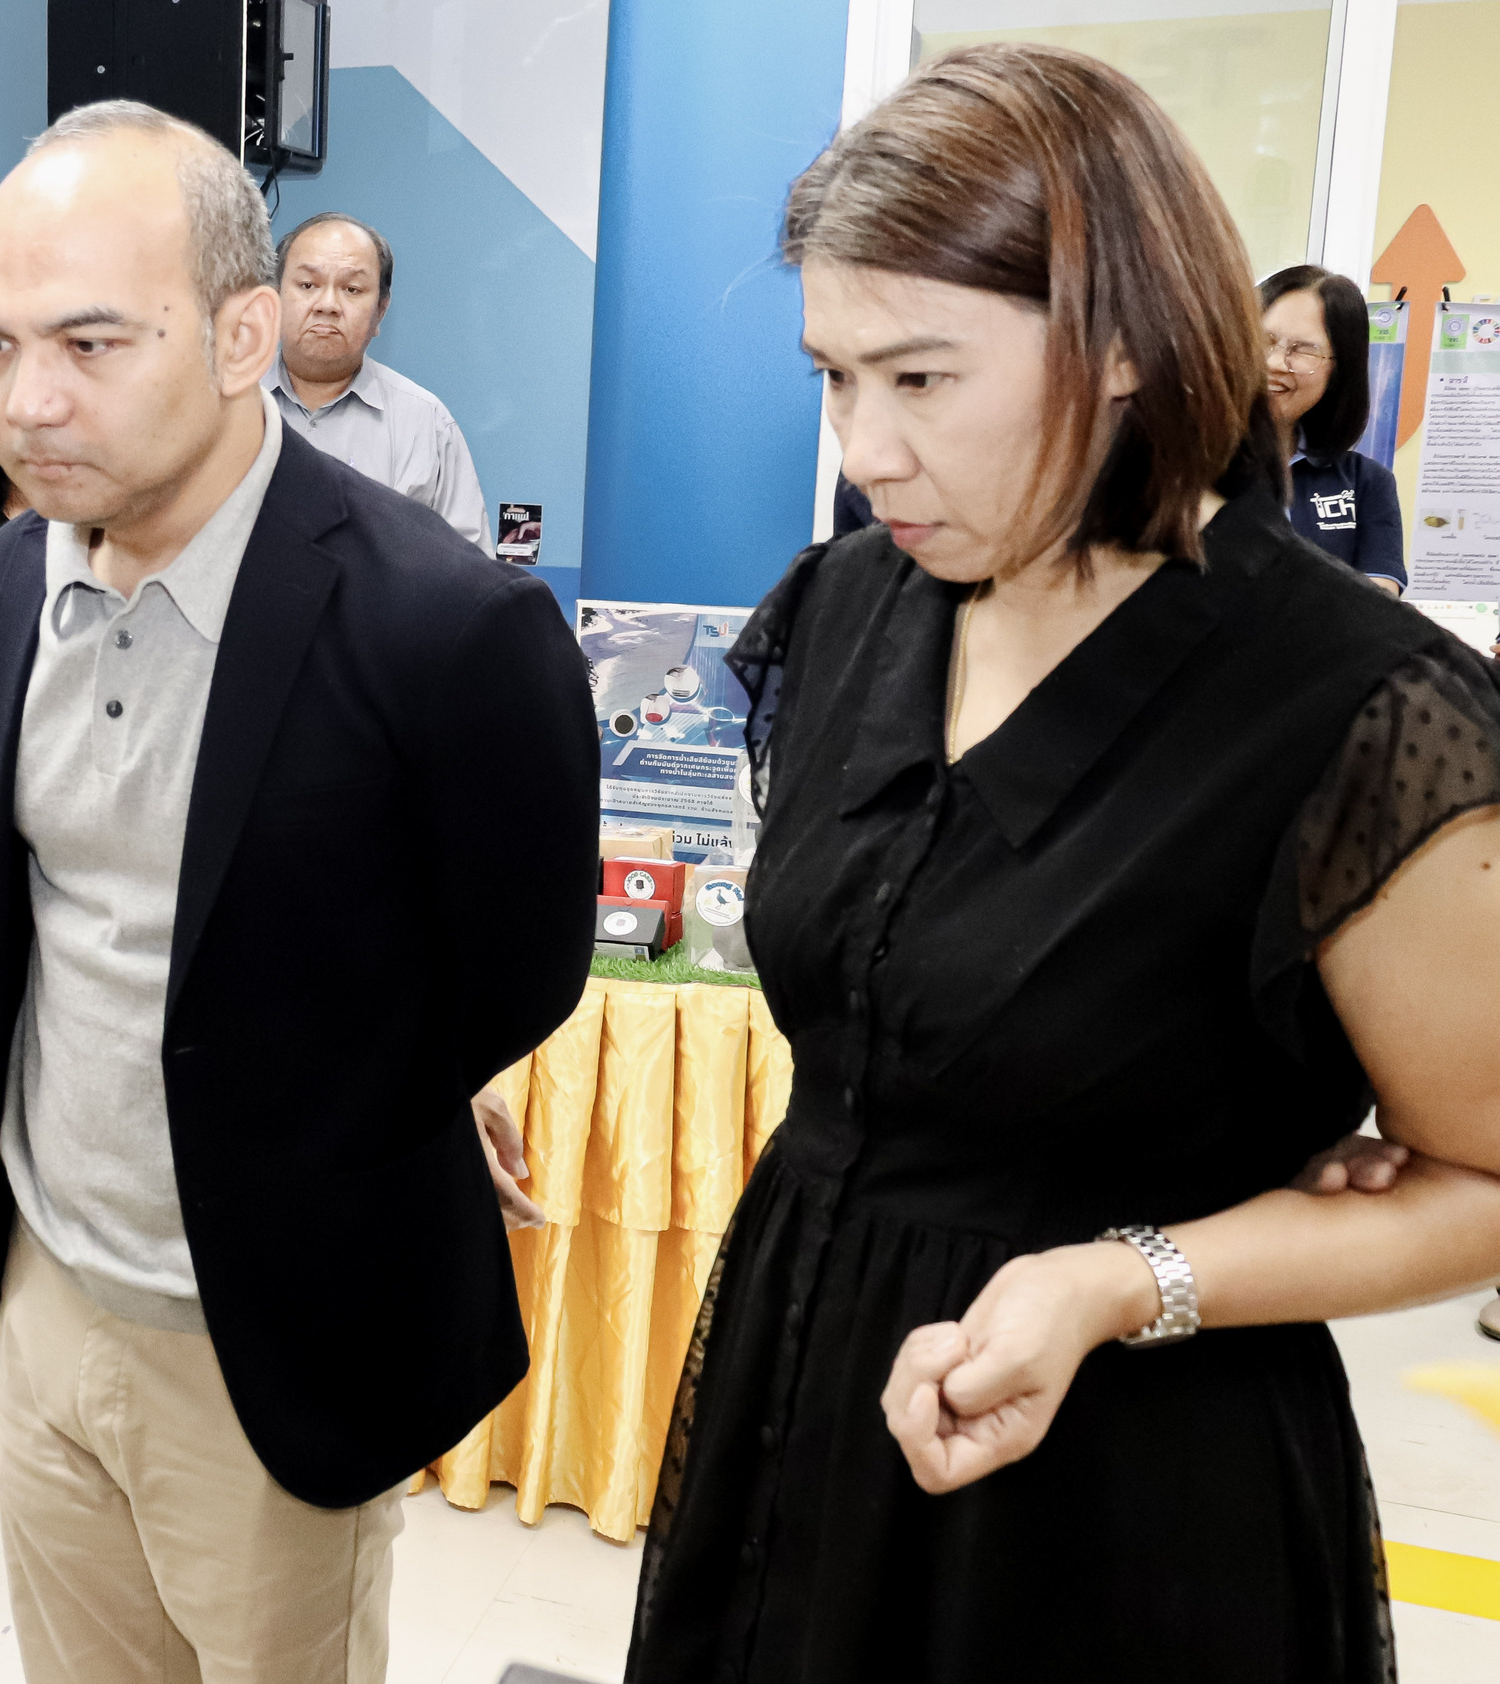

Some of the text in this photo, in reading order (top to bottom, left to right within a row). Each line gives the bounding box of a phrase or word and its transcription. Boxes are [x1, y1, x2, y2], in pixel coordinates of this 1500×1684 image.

[703, 622, 728, 638] TSU
[639, 758, 737, 773] ถ่านกัมมันต์จากเศษกระจูดเพื่อ
[660, 767, 736, 780] ทางน้ำในลุ่มทะเลสาบสง
[672, 830, 692, 845] ่วม
